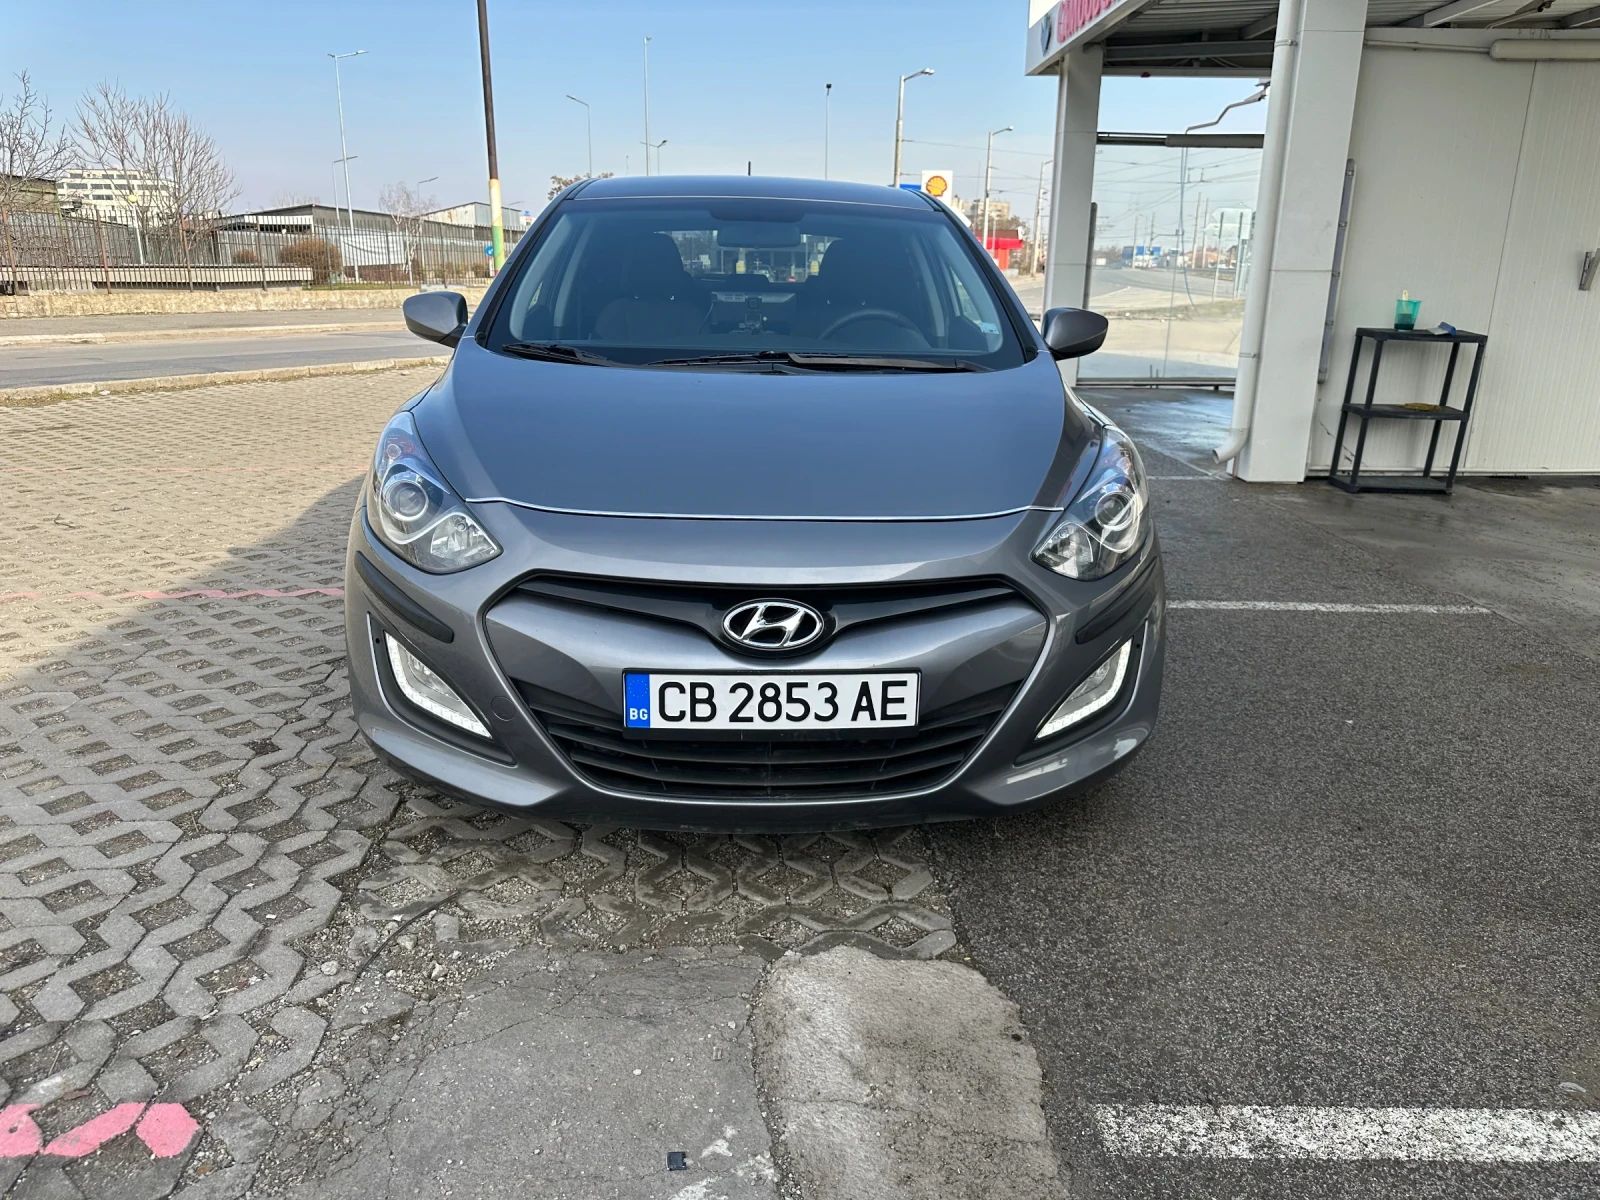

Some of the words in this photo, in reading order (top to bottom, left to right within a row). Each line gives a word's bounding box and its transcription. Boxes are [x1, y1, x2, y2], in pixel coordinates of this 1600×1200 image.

[629, 707, 648, 721] BG
[658, 681, 717, 723] CB
[728, 681, 839, 723] 2853
[850, 680, 908, 722] AE
